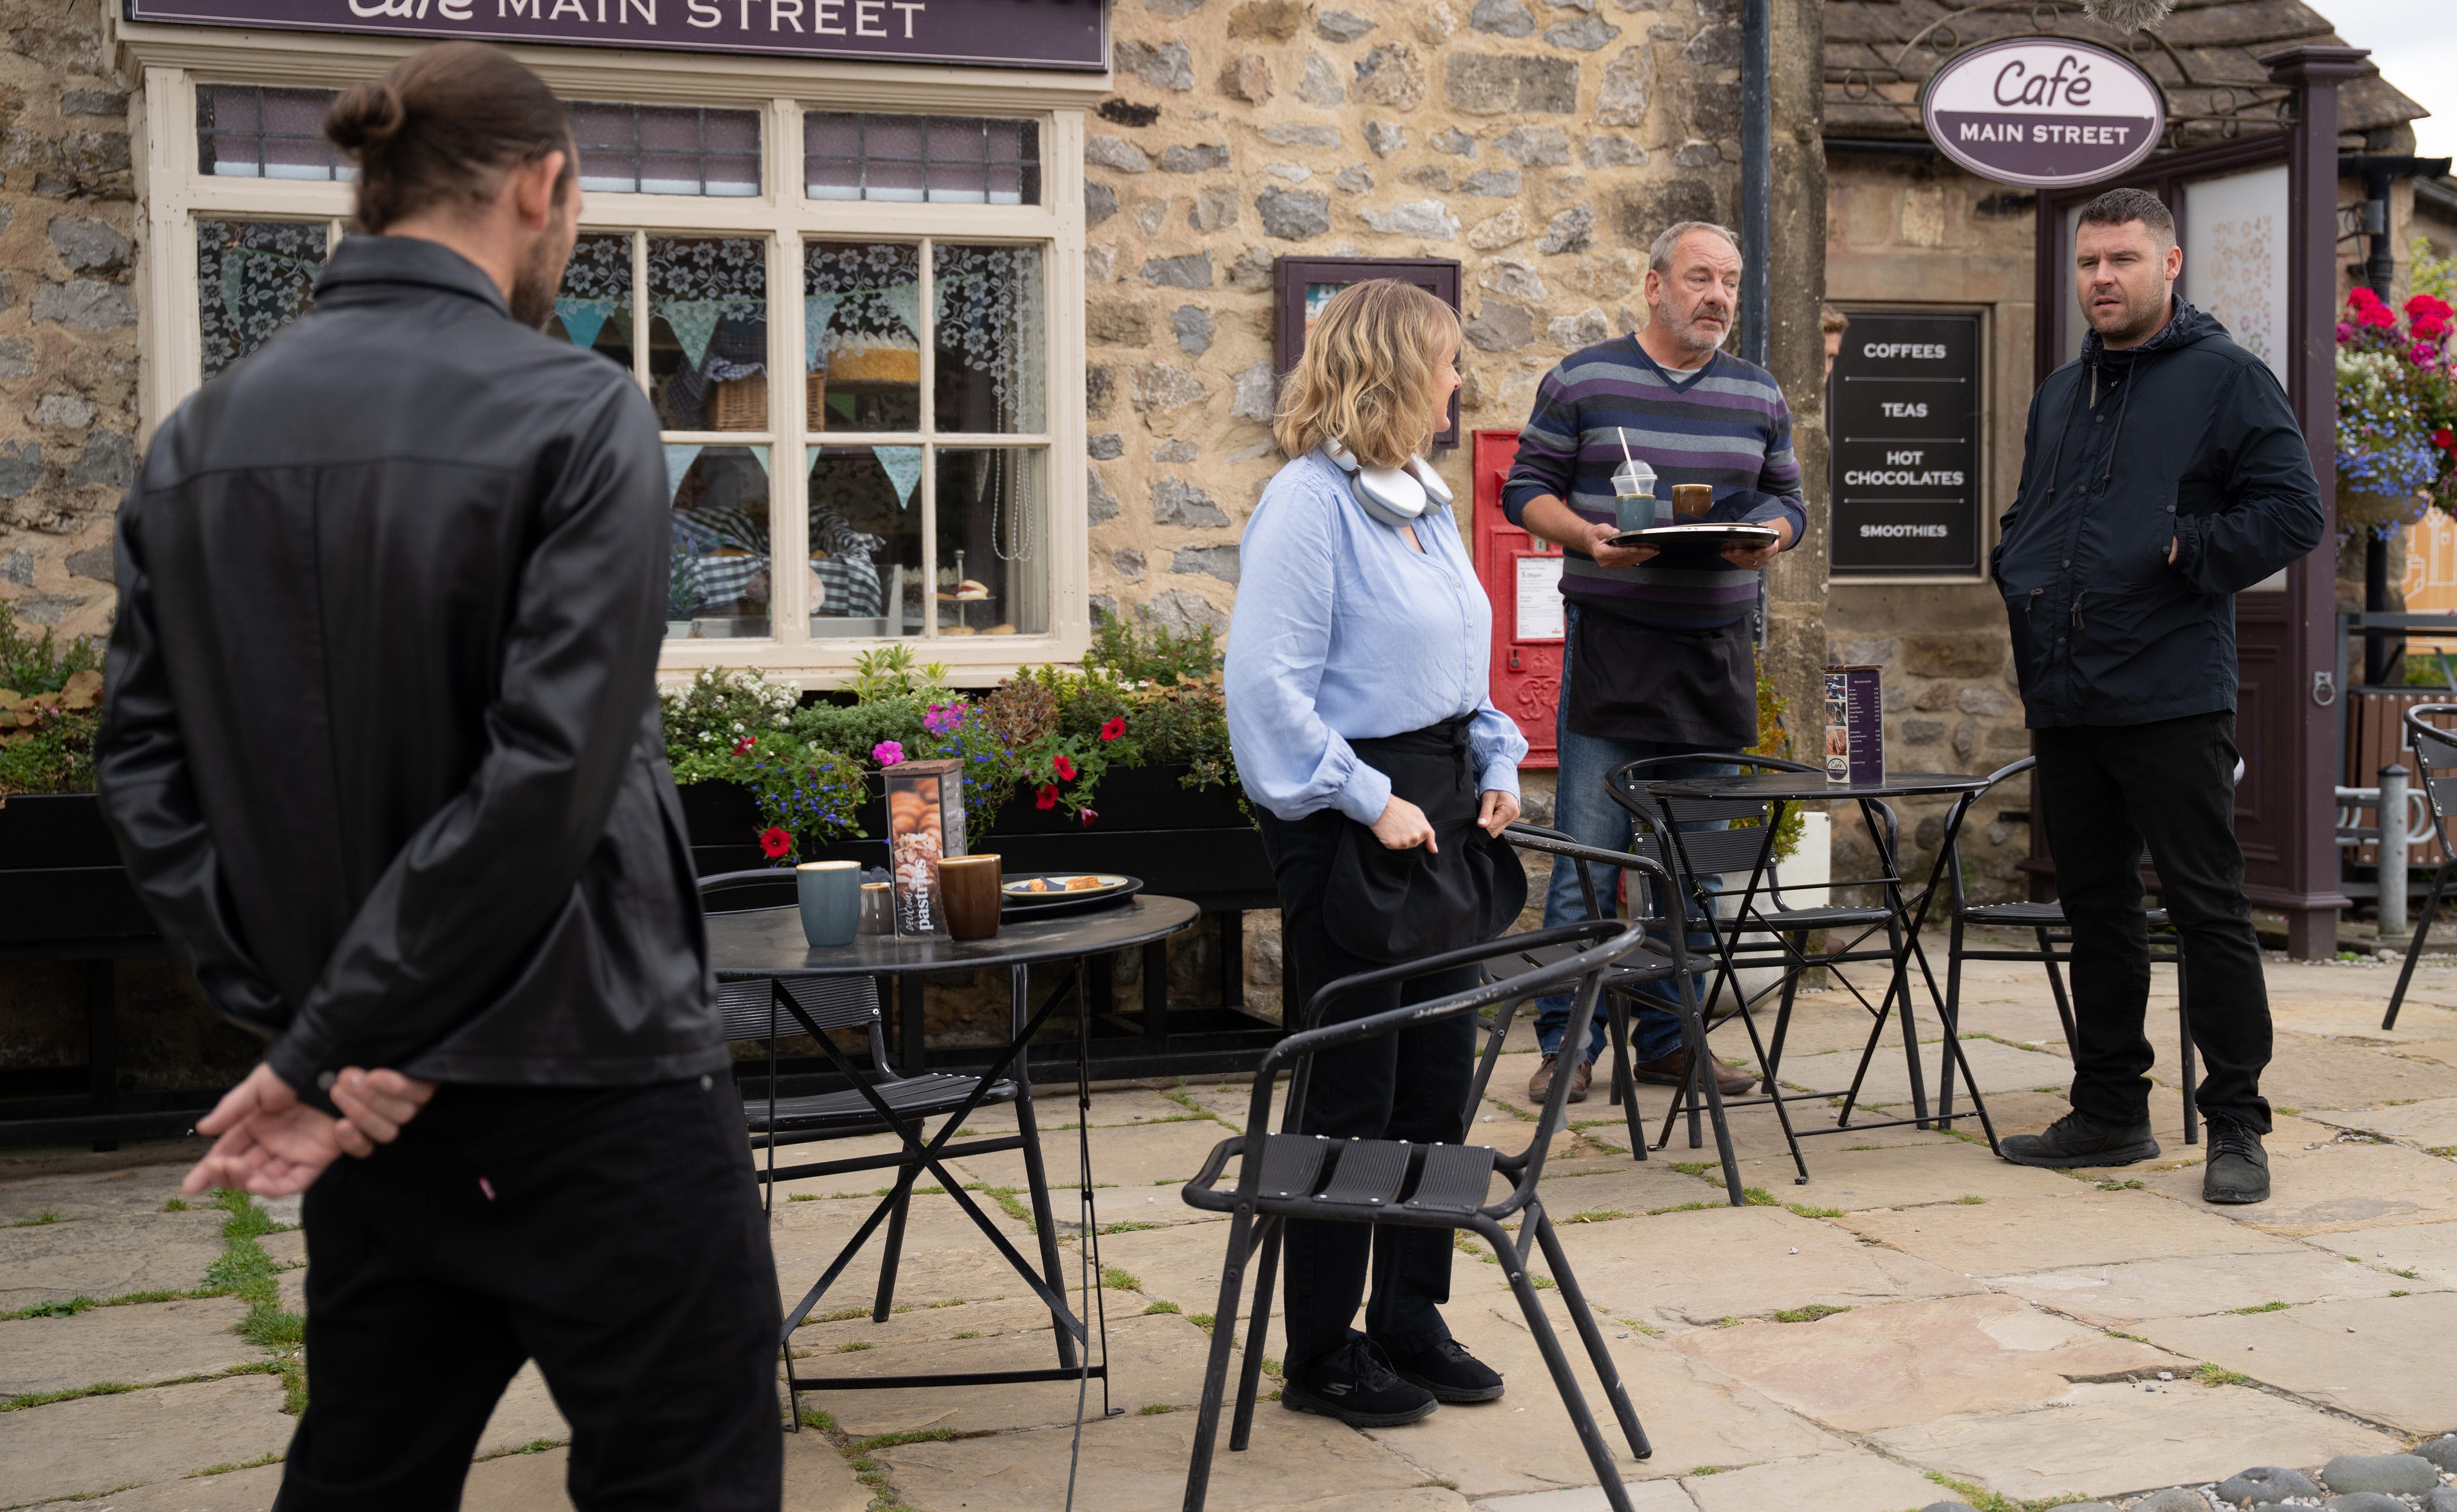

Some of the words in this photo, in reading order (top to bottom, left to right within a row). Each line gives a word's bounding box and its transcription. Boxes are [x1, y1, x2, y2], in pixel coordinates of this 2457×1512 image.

[686, 0, 926, 38] STREET
[1994, 55, 2092, 107] Café
[1959, 122, 2024, 142] MAIN
[2032, 125, 2130, 145] STREET
[1863, 342, 1947, 359] COFFEES
[1881, 402, 1929, 417] TEAS
[1886, 450, 1924, 466] HOT
[1844, 471, 1965, 486] CHOCOLATES
[1859, 524, 1948, 538] SMOOTHIES
[914, 859, 934, 930] pastries
